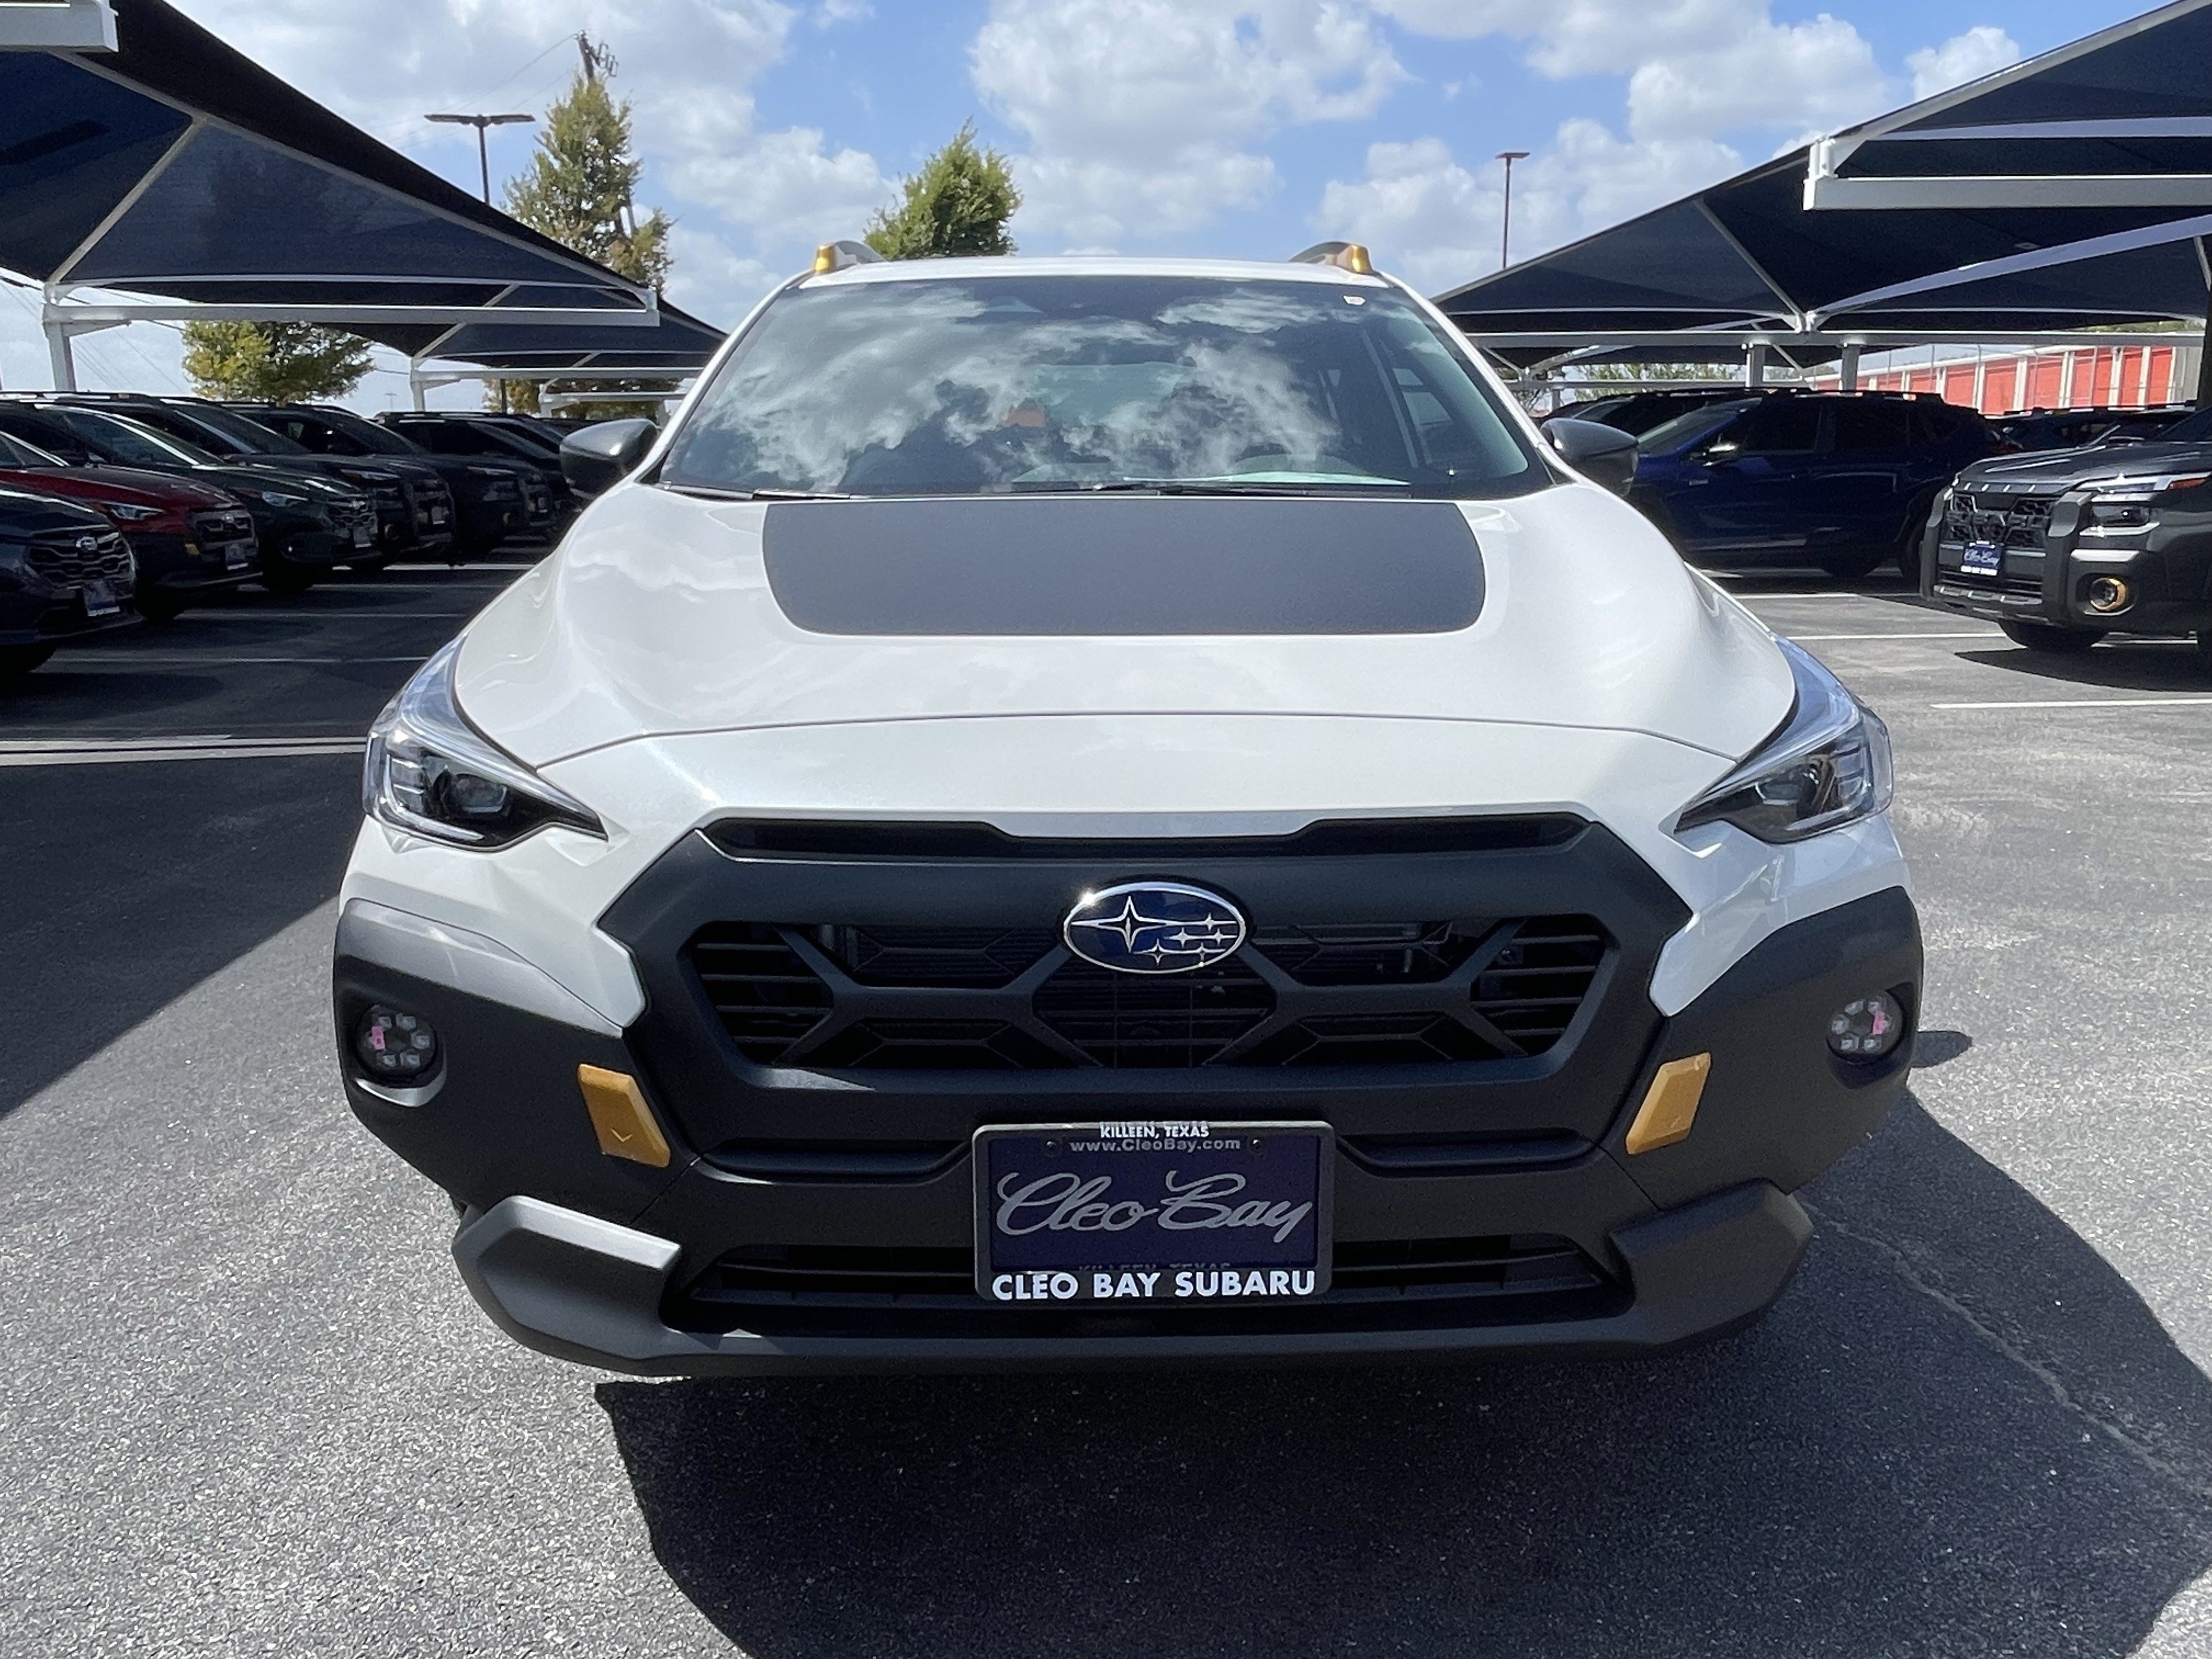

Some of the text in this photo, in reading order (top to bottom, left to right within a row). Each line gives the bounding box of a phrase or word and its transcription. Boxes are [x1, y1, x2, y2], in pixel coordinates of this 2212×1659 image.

[1163, 1124, 1209, 1138] TEXAS
[1070, 1138, 1240, 1153] www.CleoBay.com
[996, 1170, 1313, 1243] Cleo Bay
[992, 1269, 1316, 1300] CLEO BAY SUBARU
